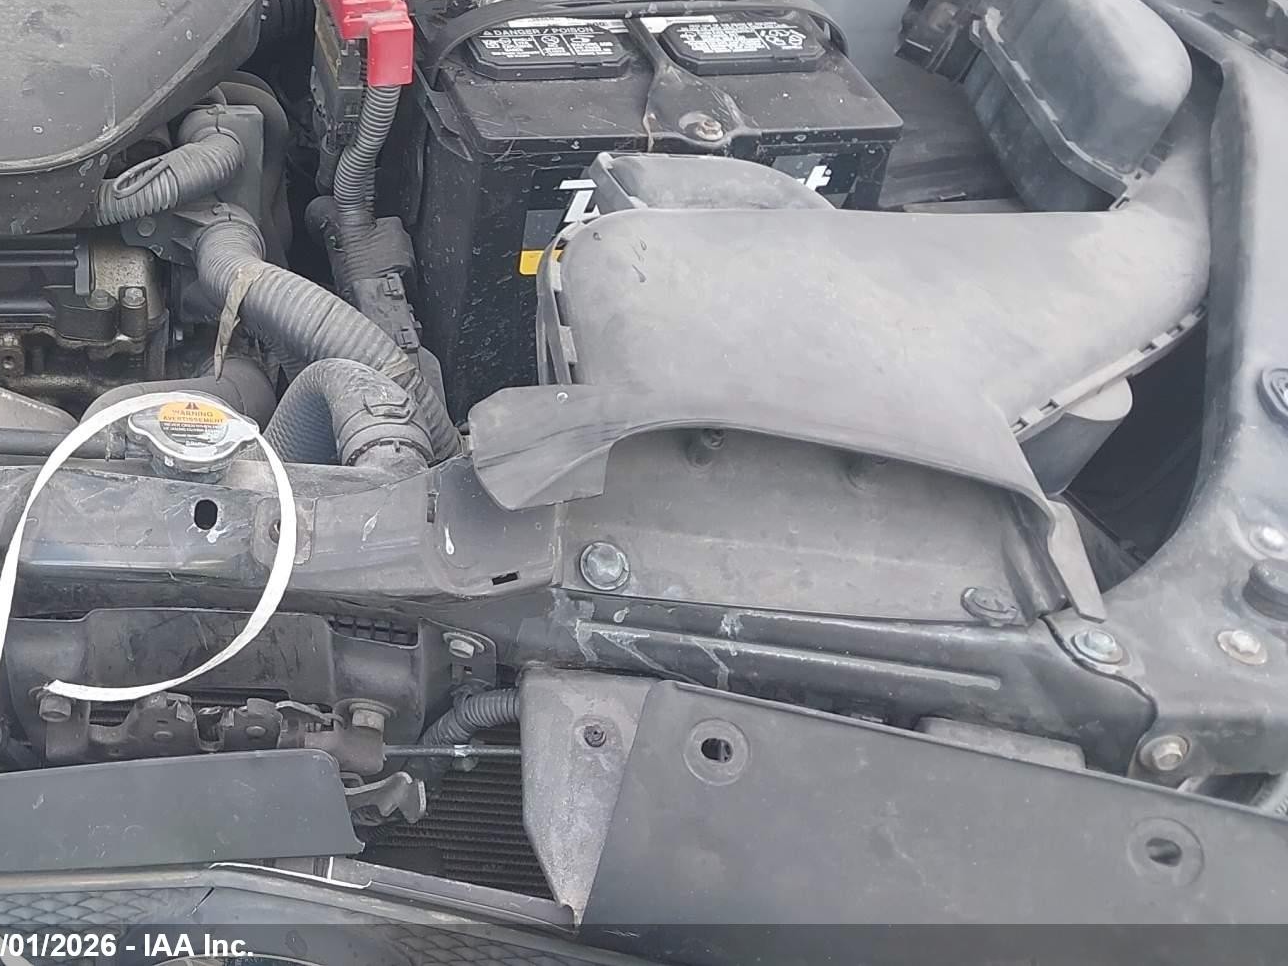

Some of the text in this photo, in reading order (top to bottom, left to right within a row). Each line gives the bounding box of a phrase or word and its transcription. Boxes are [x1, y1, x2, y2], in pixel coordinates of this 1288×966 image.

[493, 27, 540, 35] DANGER
[551, 25, 594, 33] POISON
[171, 409, 214, 417] WARNING
